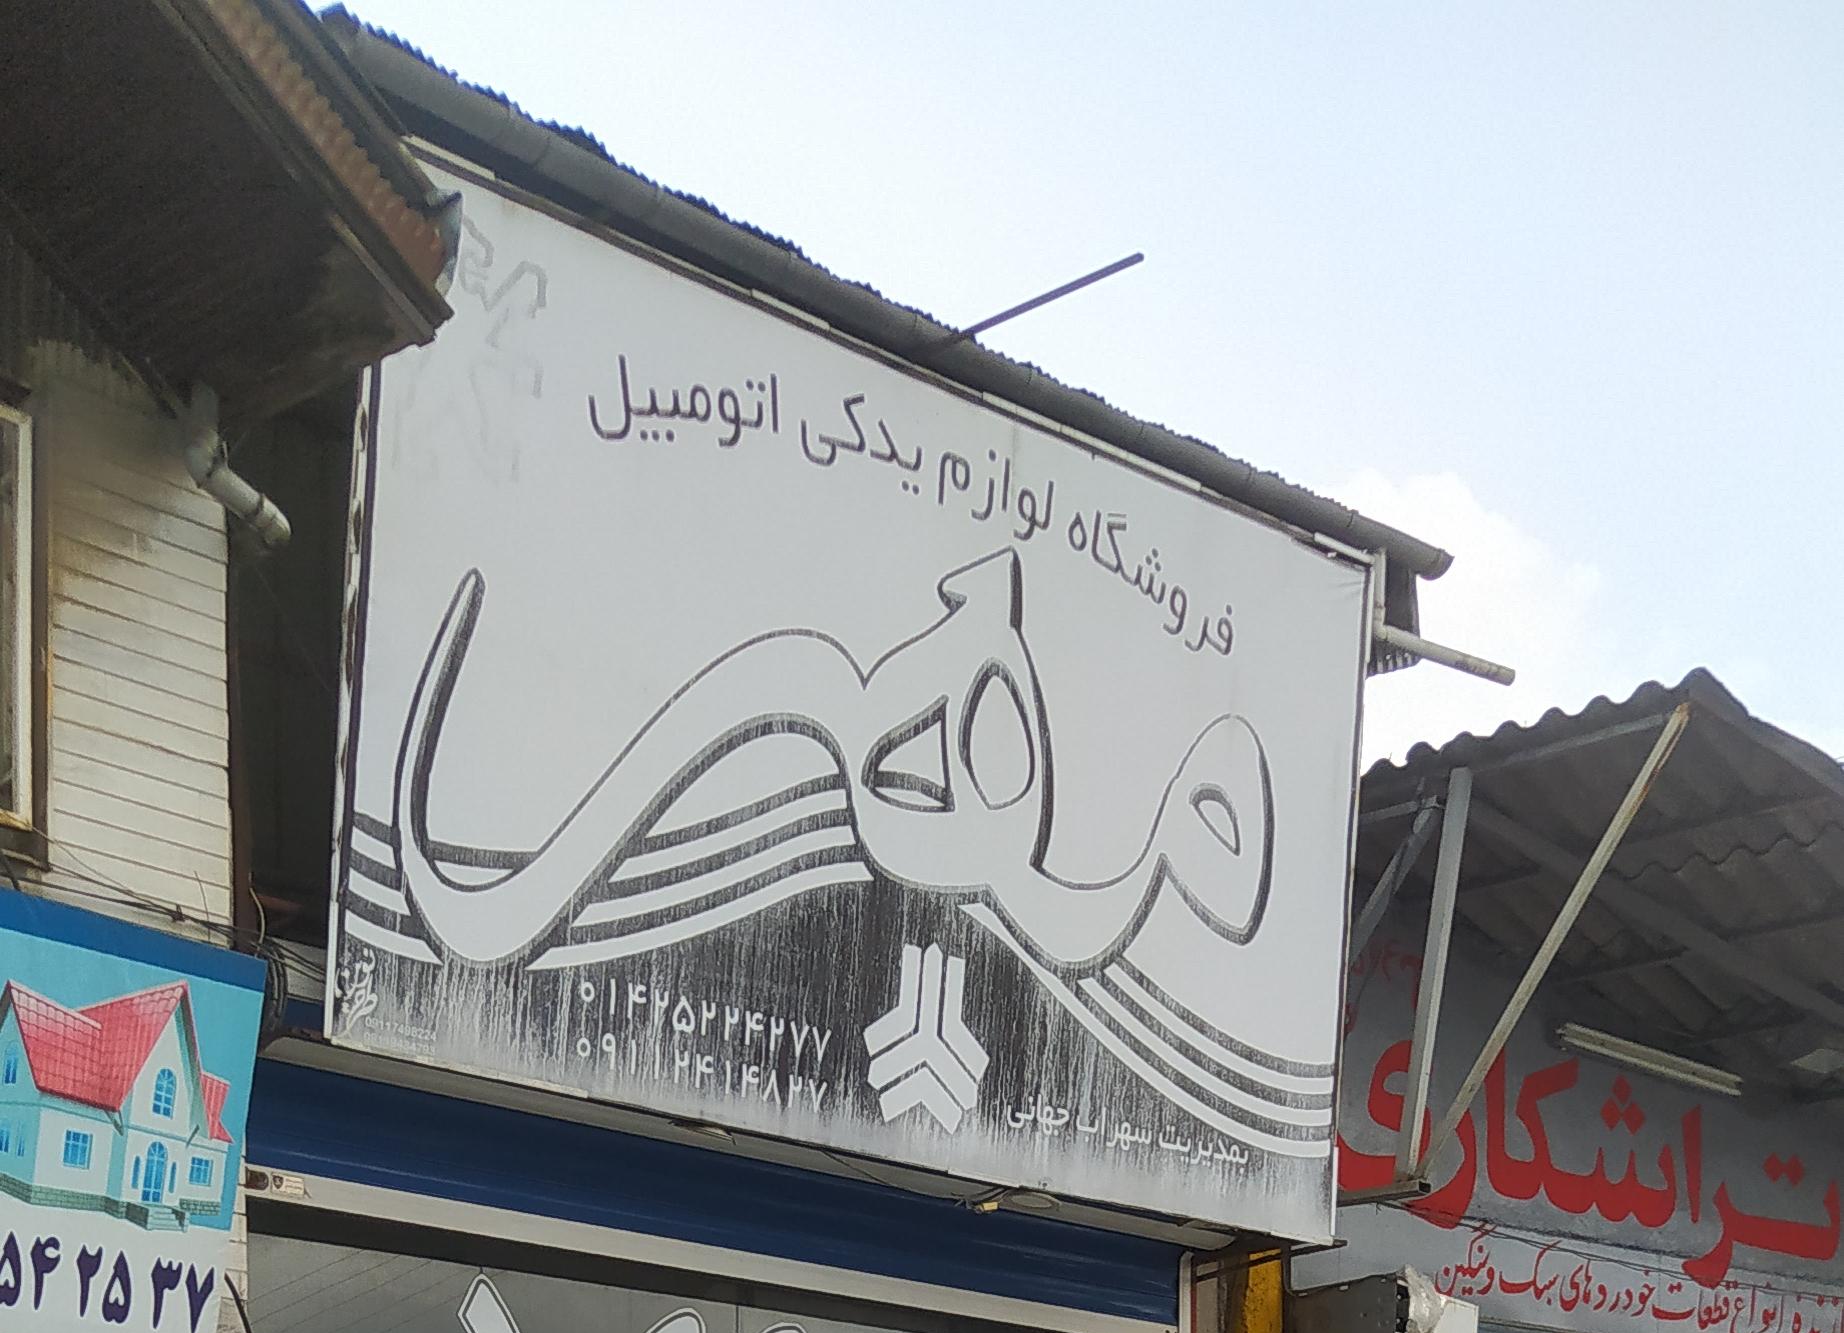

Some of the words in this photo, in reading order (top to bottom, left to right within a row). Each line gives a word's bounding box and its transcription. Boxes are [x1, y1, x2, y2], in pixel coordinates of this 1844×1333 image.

[585, 353, 780, 448] اتومبیل
[799, 392, 922, 497] یدکی
[937, 446, 1056, 544] لوازم
[1066, 511, 1237, 657] فروشگاه
[393, 547, 1275, 963] مهر
[1005, 1093, 1070, 1137] جهانی
[1076, 1104, 1153, 1152] سهراب
[1158, 1123, 1249, 1174] بمدیریت
[1651, 1279, 1740, 1331] قطعات
